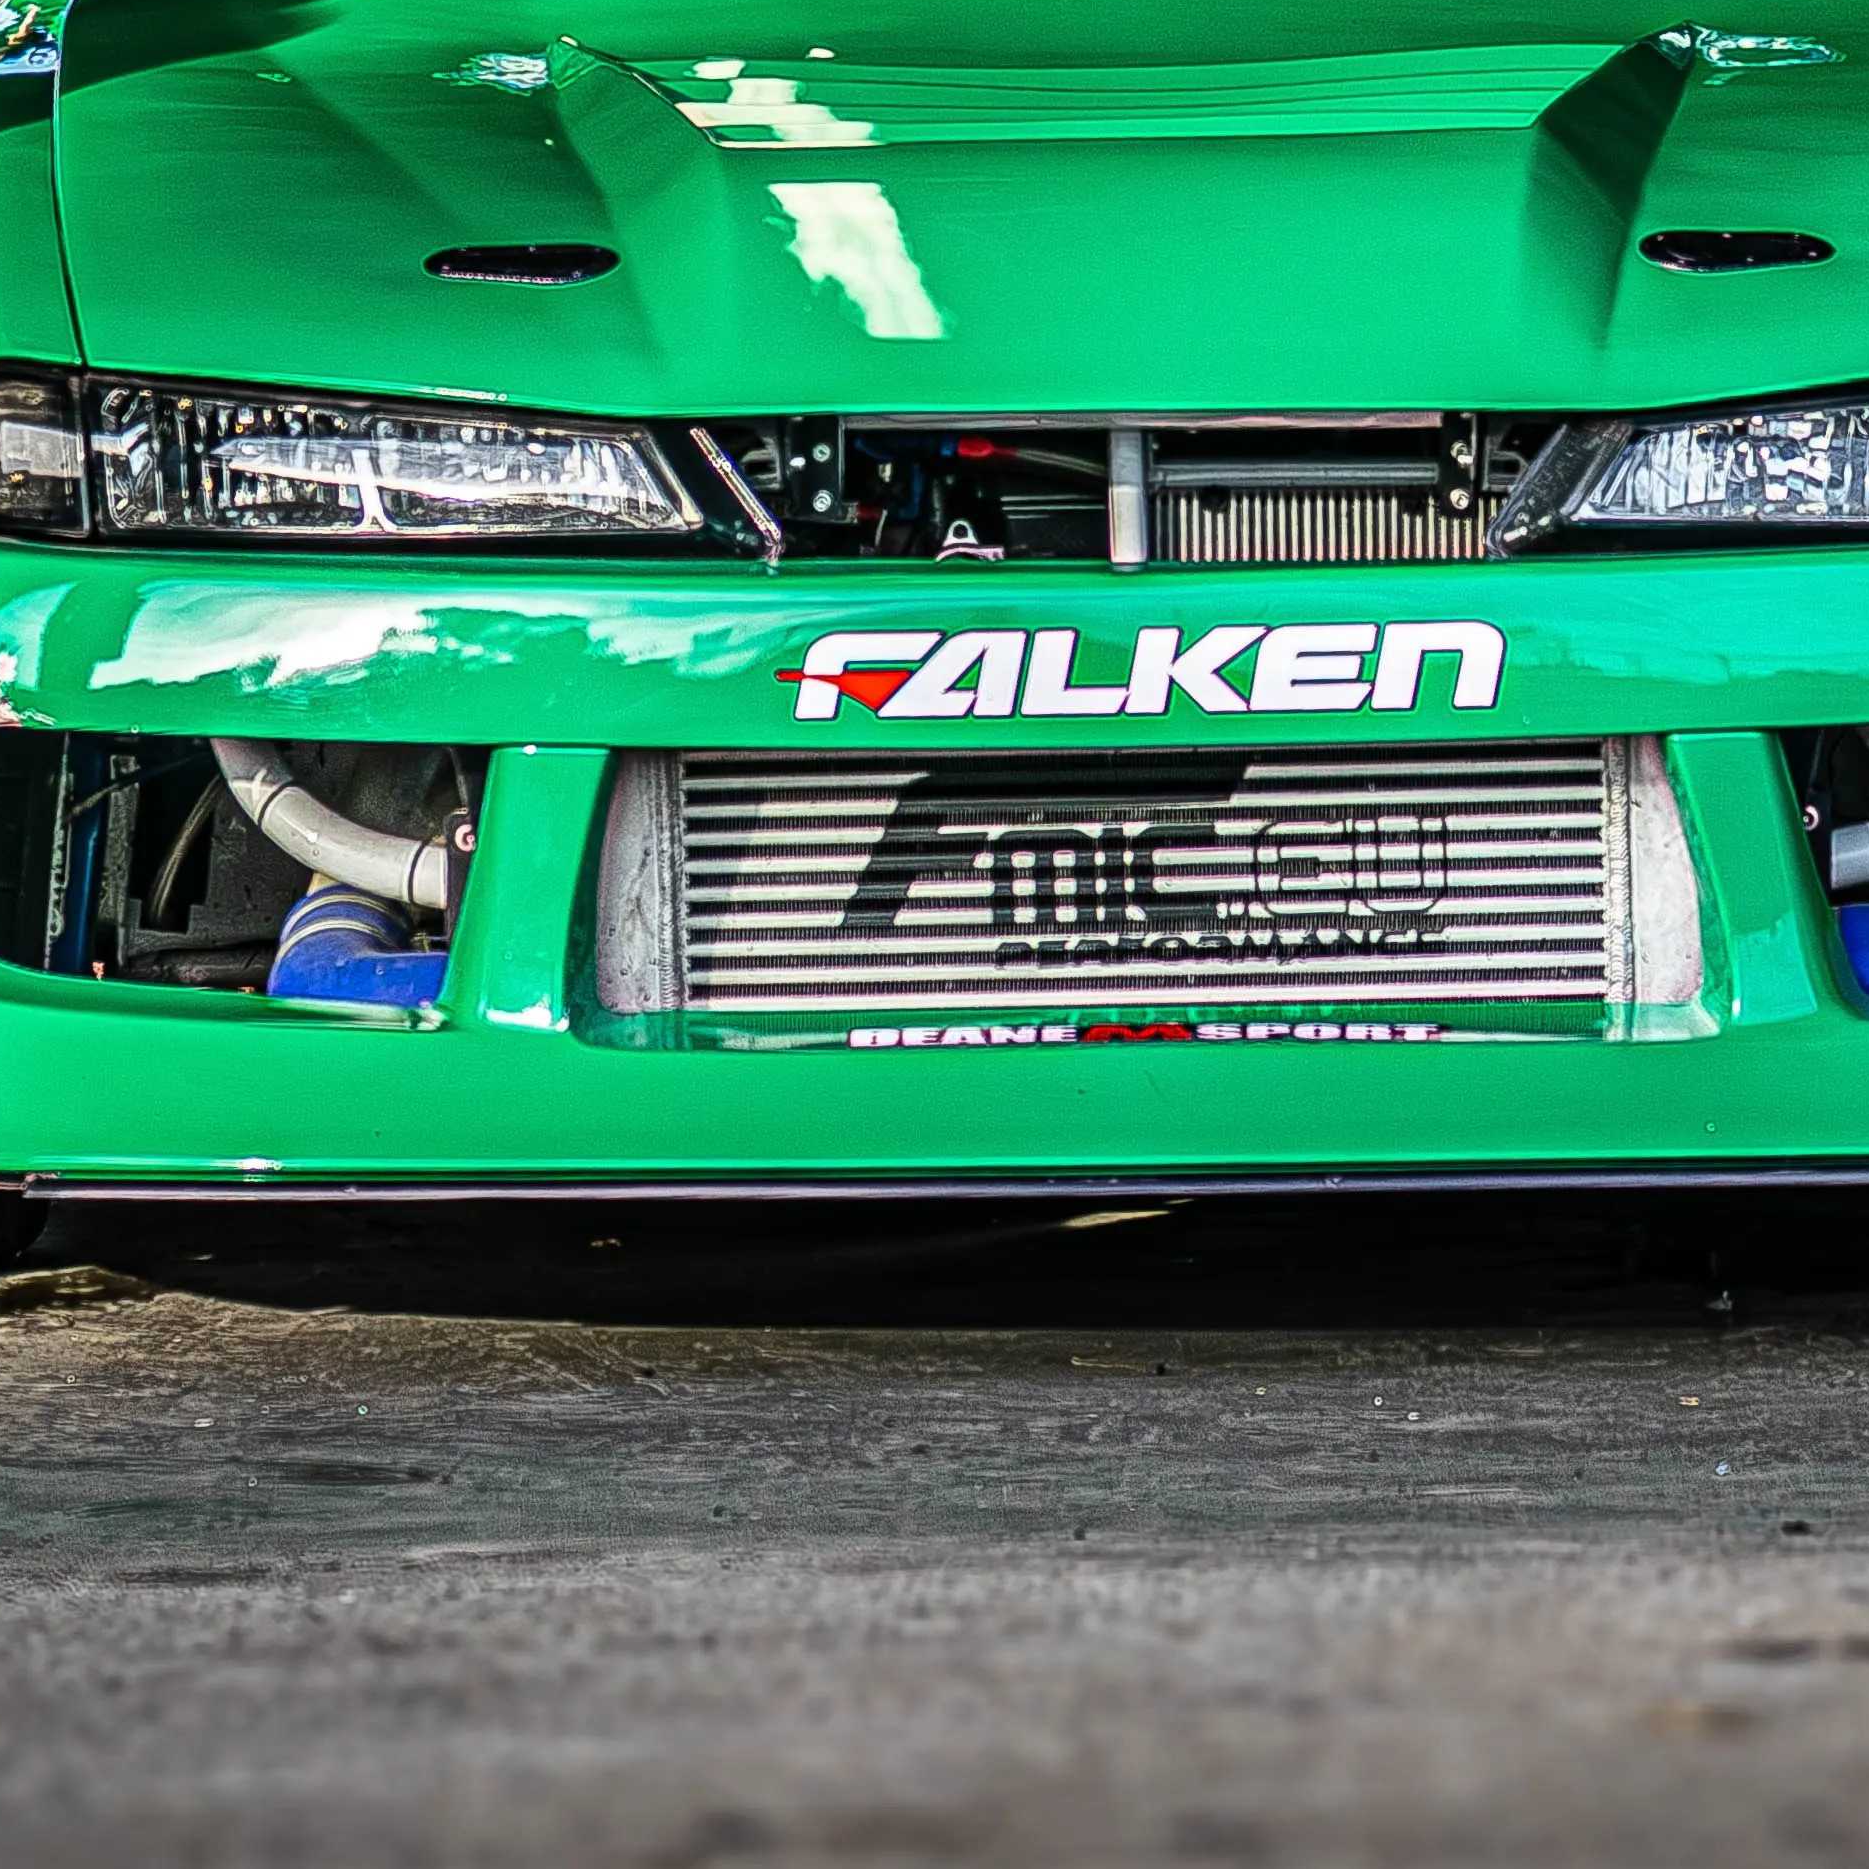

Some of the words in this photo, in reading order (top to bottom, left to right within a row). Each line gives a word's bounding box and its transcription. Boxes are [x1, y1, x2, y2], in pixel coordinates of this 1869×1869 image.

[778, 620, 1508, 721] FALKEN
[846, 1024, 1079, 1048] DEANE
[1194, 1023, 1440, 1042] SPORT
